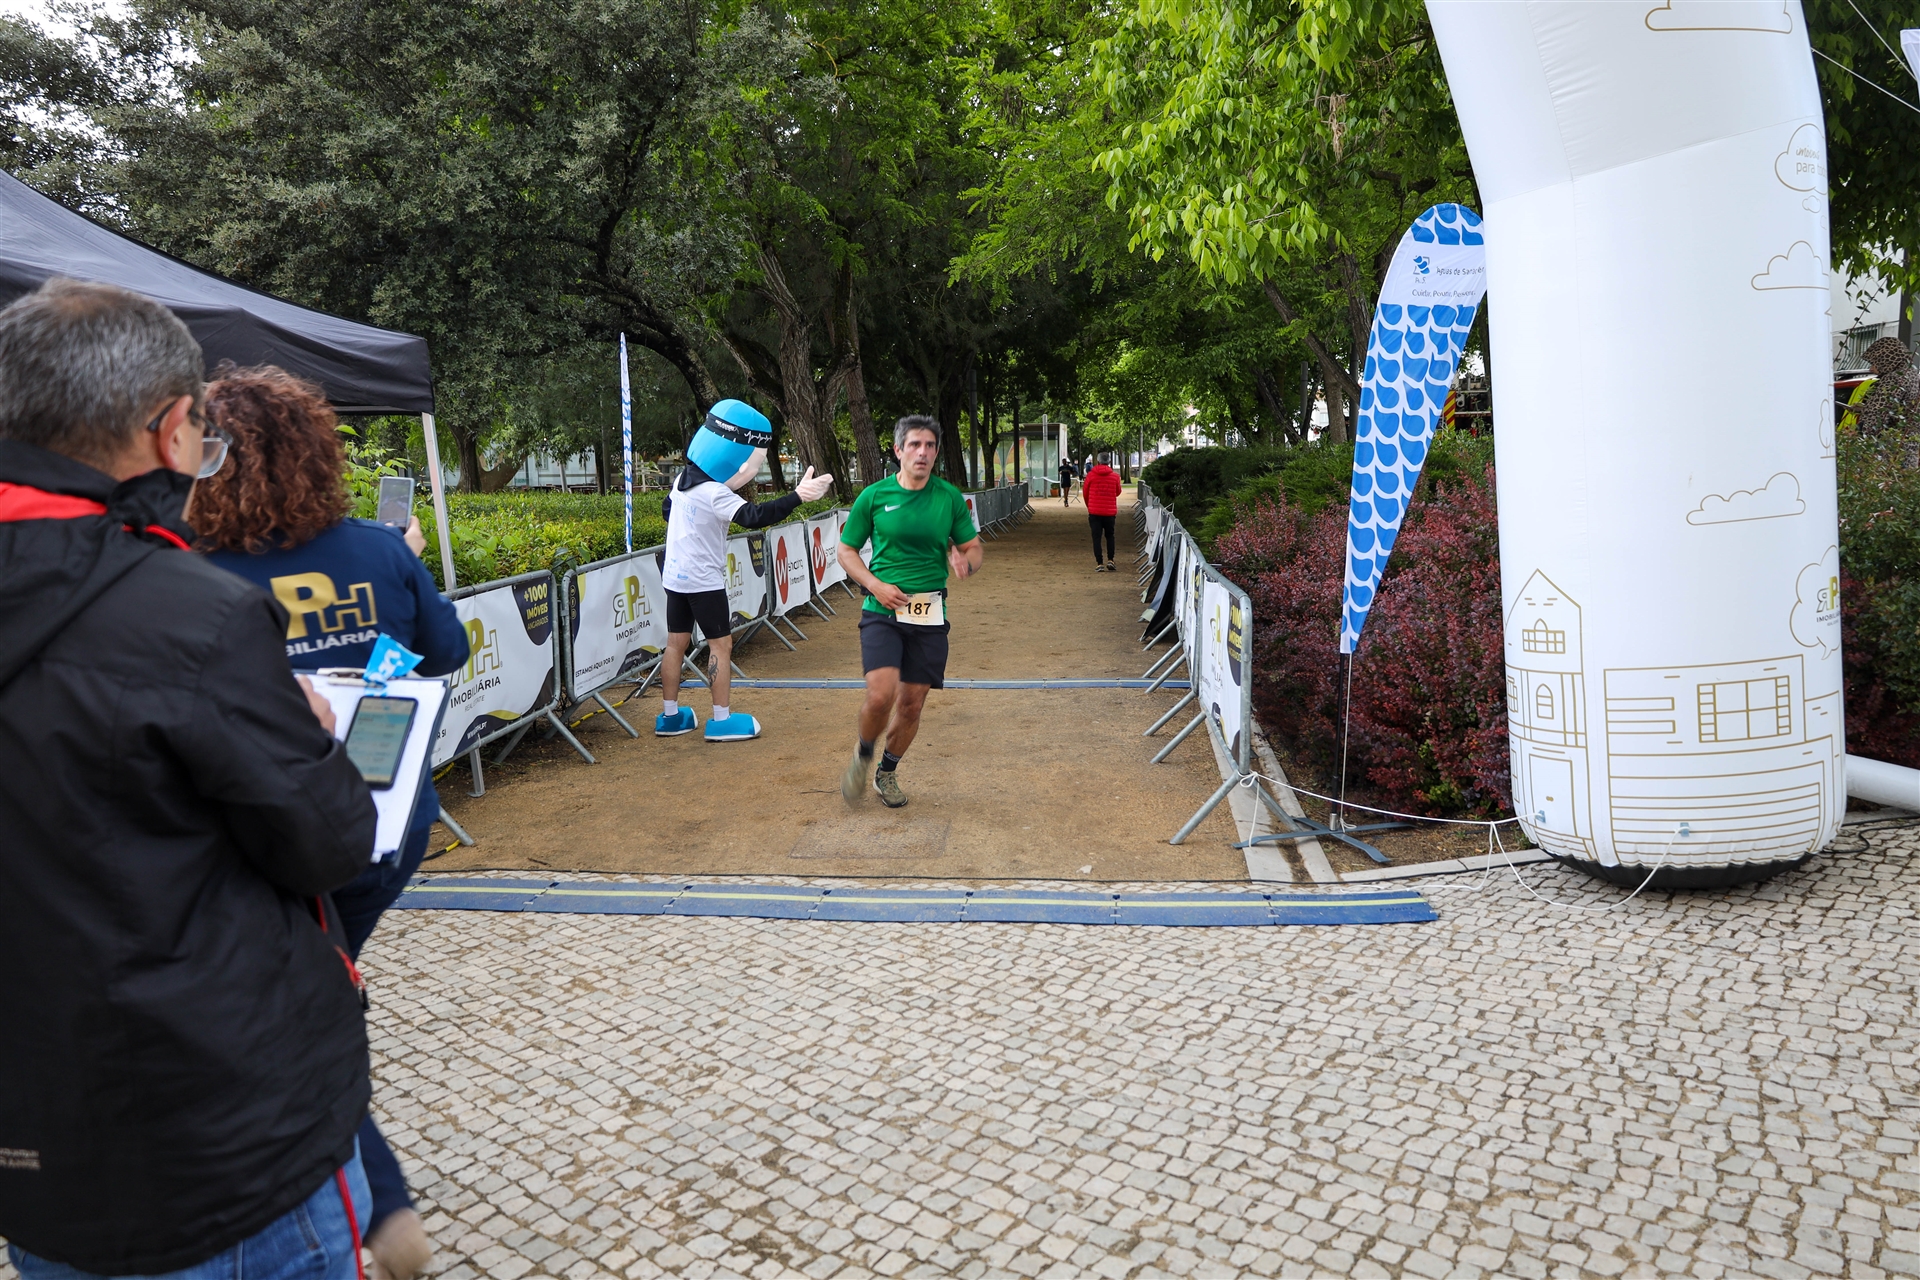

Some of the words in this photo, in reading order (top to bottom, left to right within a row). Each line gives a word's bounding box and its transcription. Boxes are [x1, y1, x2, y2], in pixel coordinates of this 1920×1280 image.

[1796, 162, 1815, 175] para
[524, 582, 548, 603] +1000
[526, 601, 548, 619] IMÓVEIS
[905, 602, 931, 615] 187
[450, 675, 502, 709] IMOBILIÁRIA
